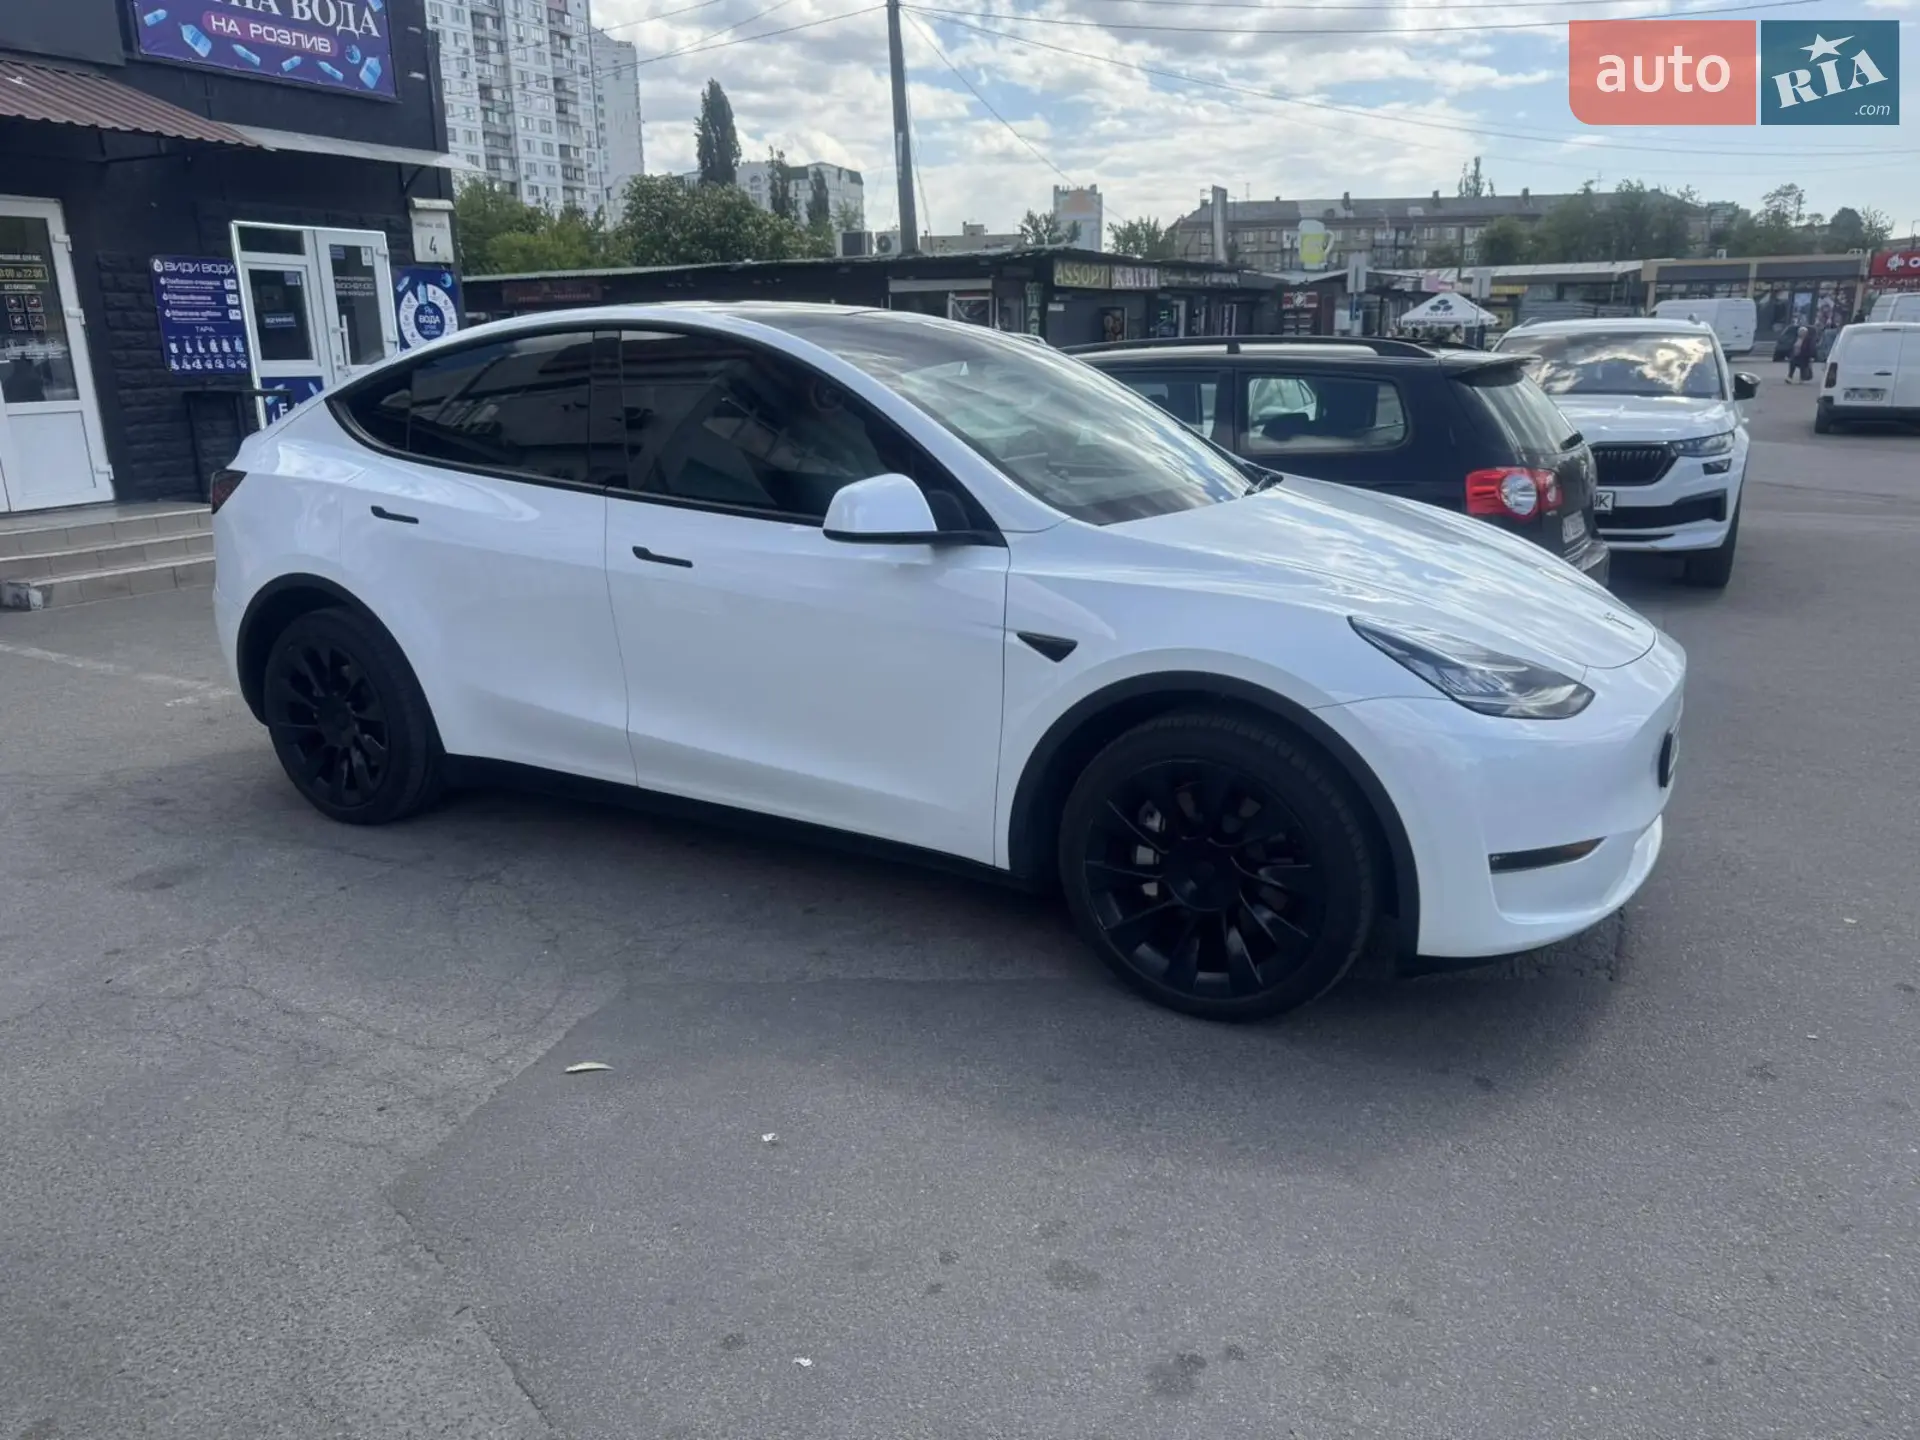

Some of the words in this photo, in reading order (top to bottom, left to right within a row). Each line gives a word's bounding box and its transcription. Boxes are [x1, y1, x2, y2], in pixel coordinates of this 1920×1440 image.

[211, 14, 241, 36] НА
[250, 23, 331, 53] РОЗЛИВ
[290, 0, 381, 39] ВОДА
[429, 236, 436, 255] 4
[418, 314, 441, 324] ВОДА
